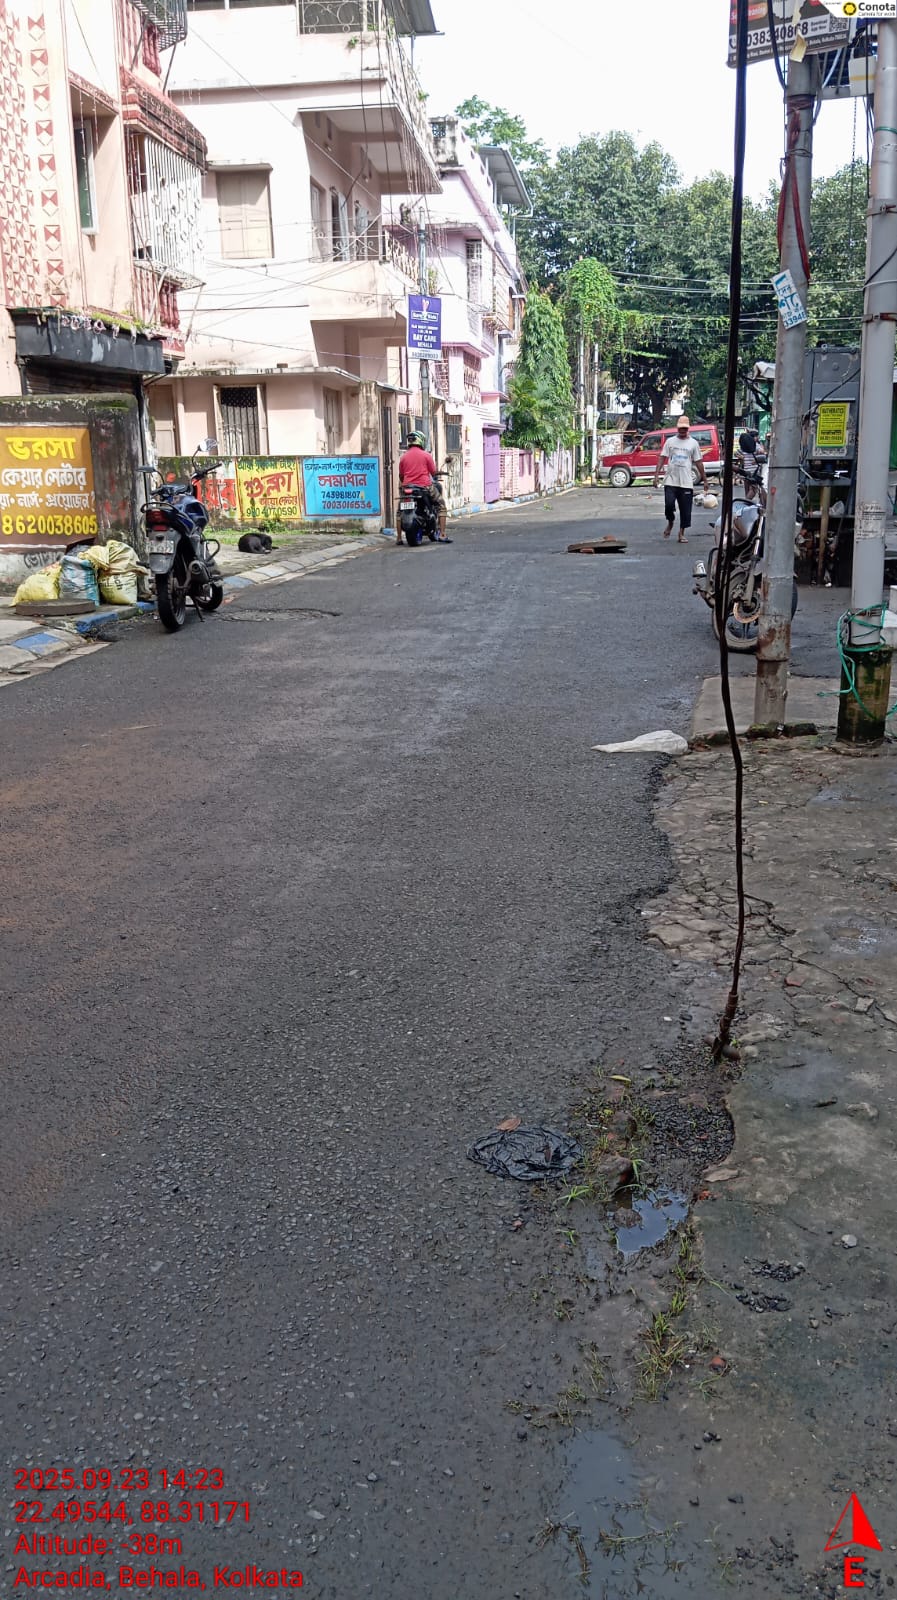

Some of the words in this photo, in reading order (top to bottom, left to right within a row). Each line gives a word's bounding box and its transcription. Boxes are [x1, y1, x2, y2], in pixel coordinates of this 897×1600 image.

[746, 21, 809, 47] 038340868
[6, 436, 76, 460] ভরসা
[1, 468, 43, 489] কেয়ার
[45, 463, 86, 490] সেন্টার
[243, 471, 294, 498] শুক্লা
[318, 471, 367, 487] সমাধান
[2, 515, 98, 536] 8620038605
